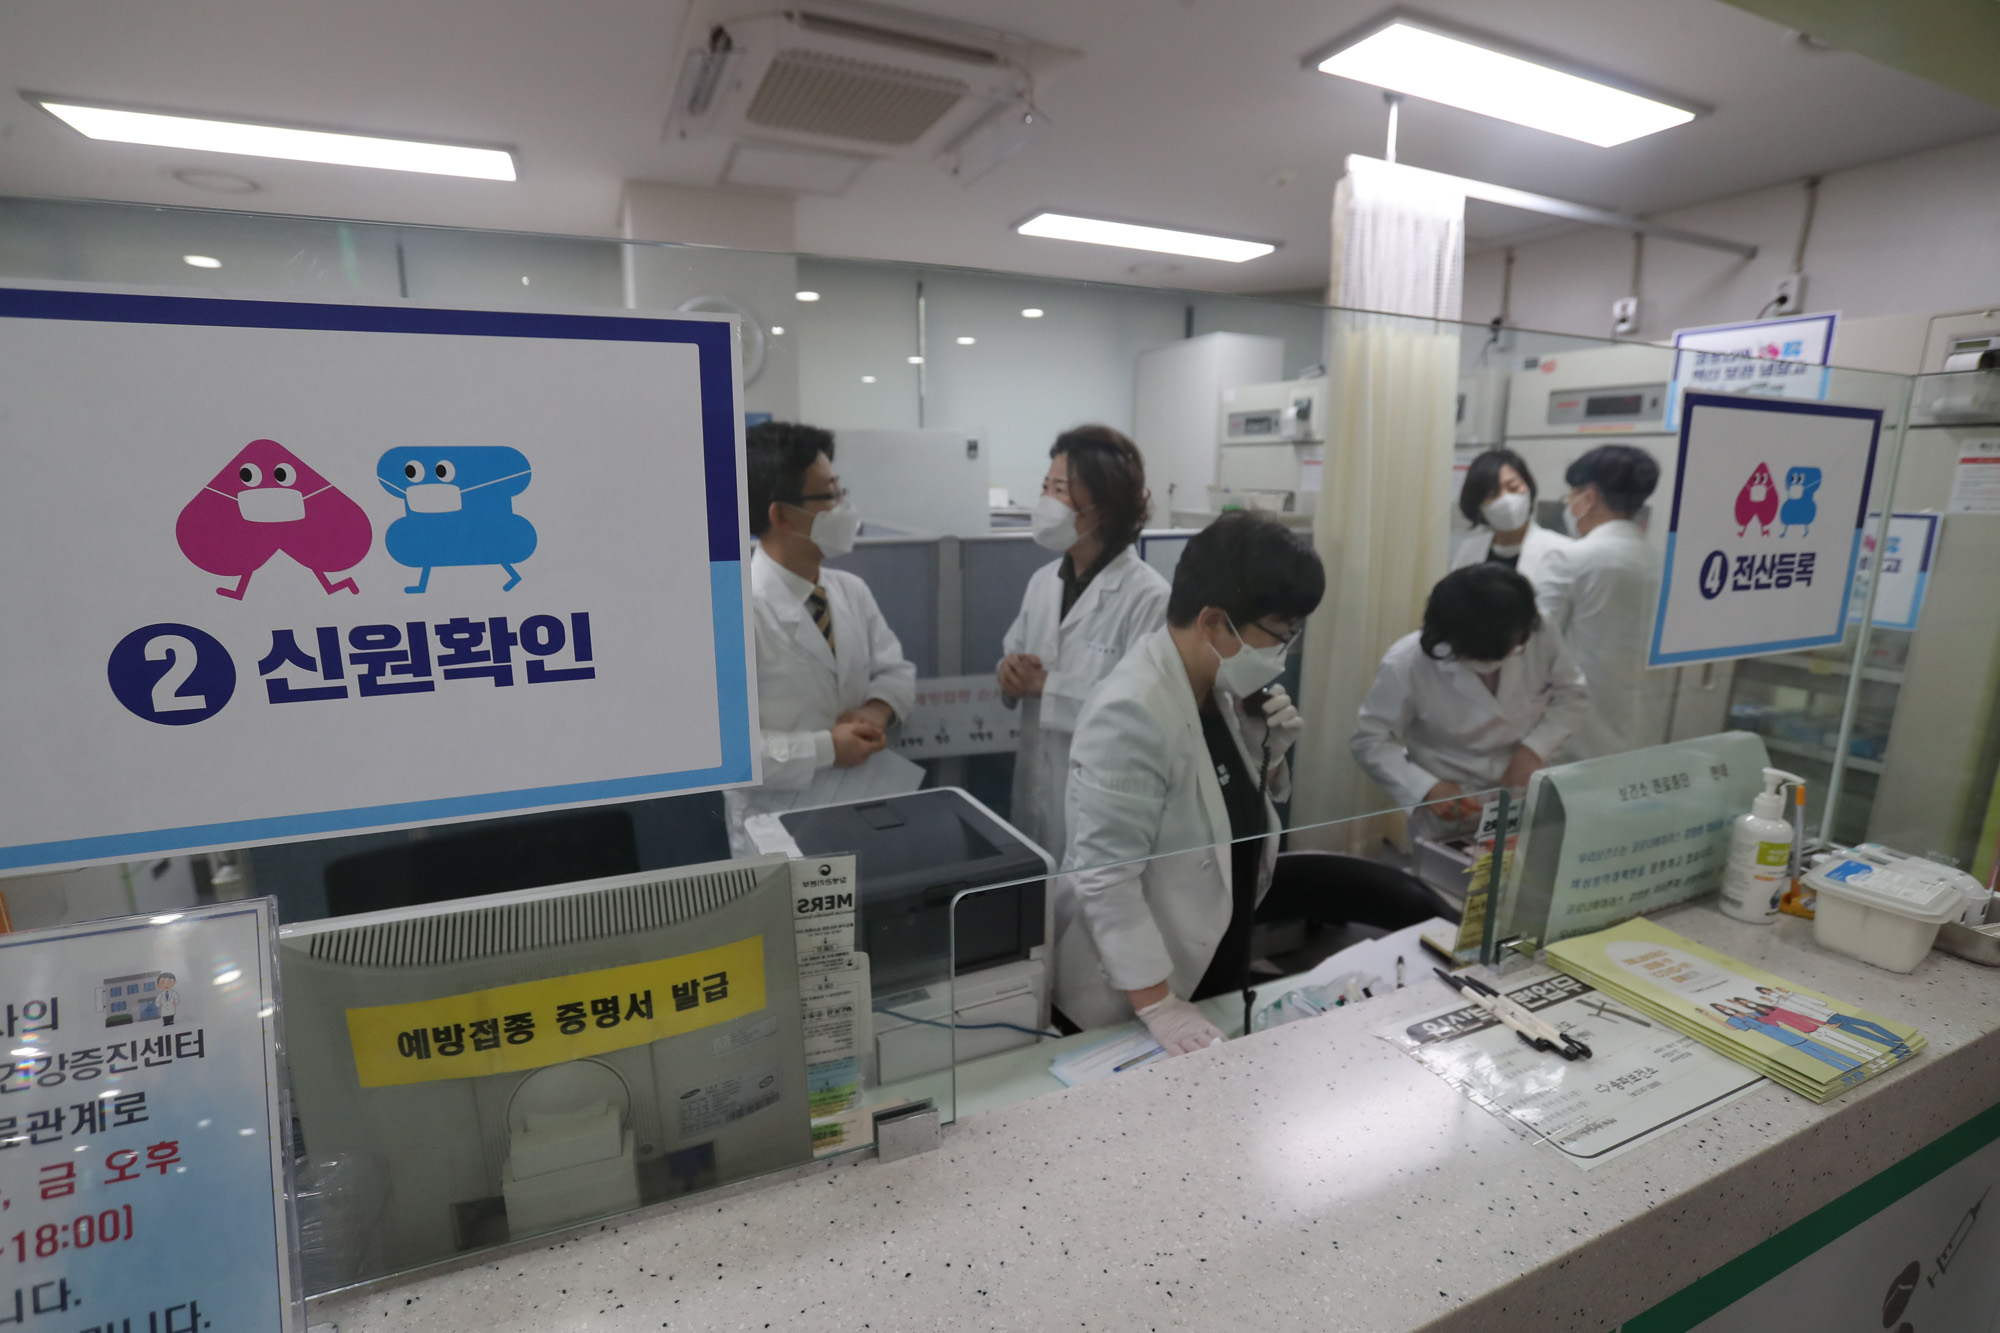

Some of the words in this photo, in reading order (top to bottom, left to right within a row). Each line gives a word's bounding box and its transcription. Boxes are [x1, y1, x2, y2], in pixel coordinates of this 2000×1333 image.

[1731, 552, 1816, 592] 전산등록
[257, 612, 596, 704] 신원확인
[1618, 783, 1650, 802] 보건소
[398, 1012, 536, 1061] 예방접종
[555, 990, 654, 1036] 증명서
[672, 971, 730, 1013] 발급
[0, 1029, 206, 1095] 건강증진센터
[1610, 1066, 1660, 1091] 송파보건소
[39, 1162, 76, 1200] 금
[104, 1141, 182, 1186] 오후
[0, 1204, 134, 1263] 18:00)
